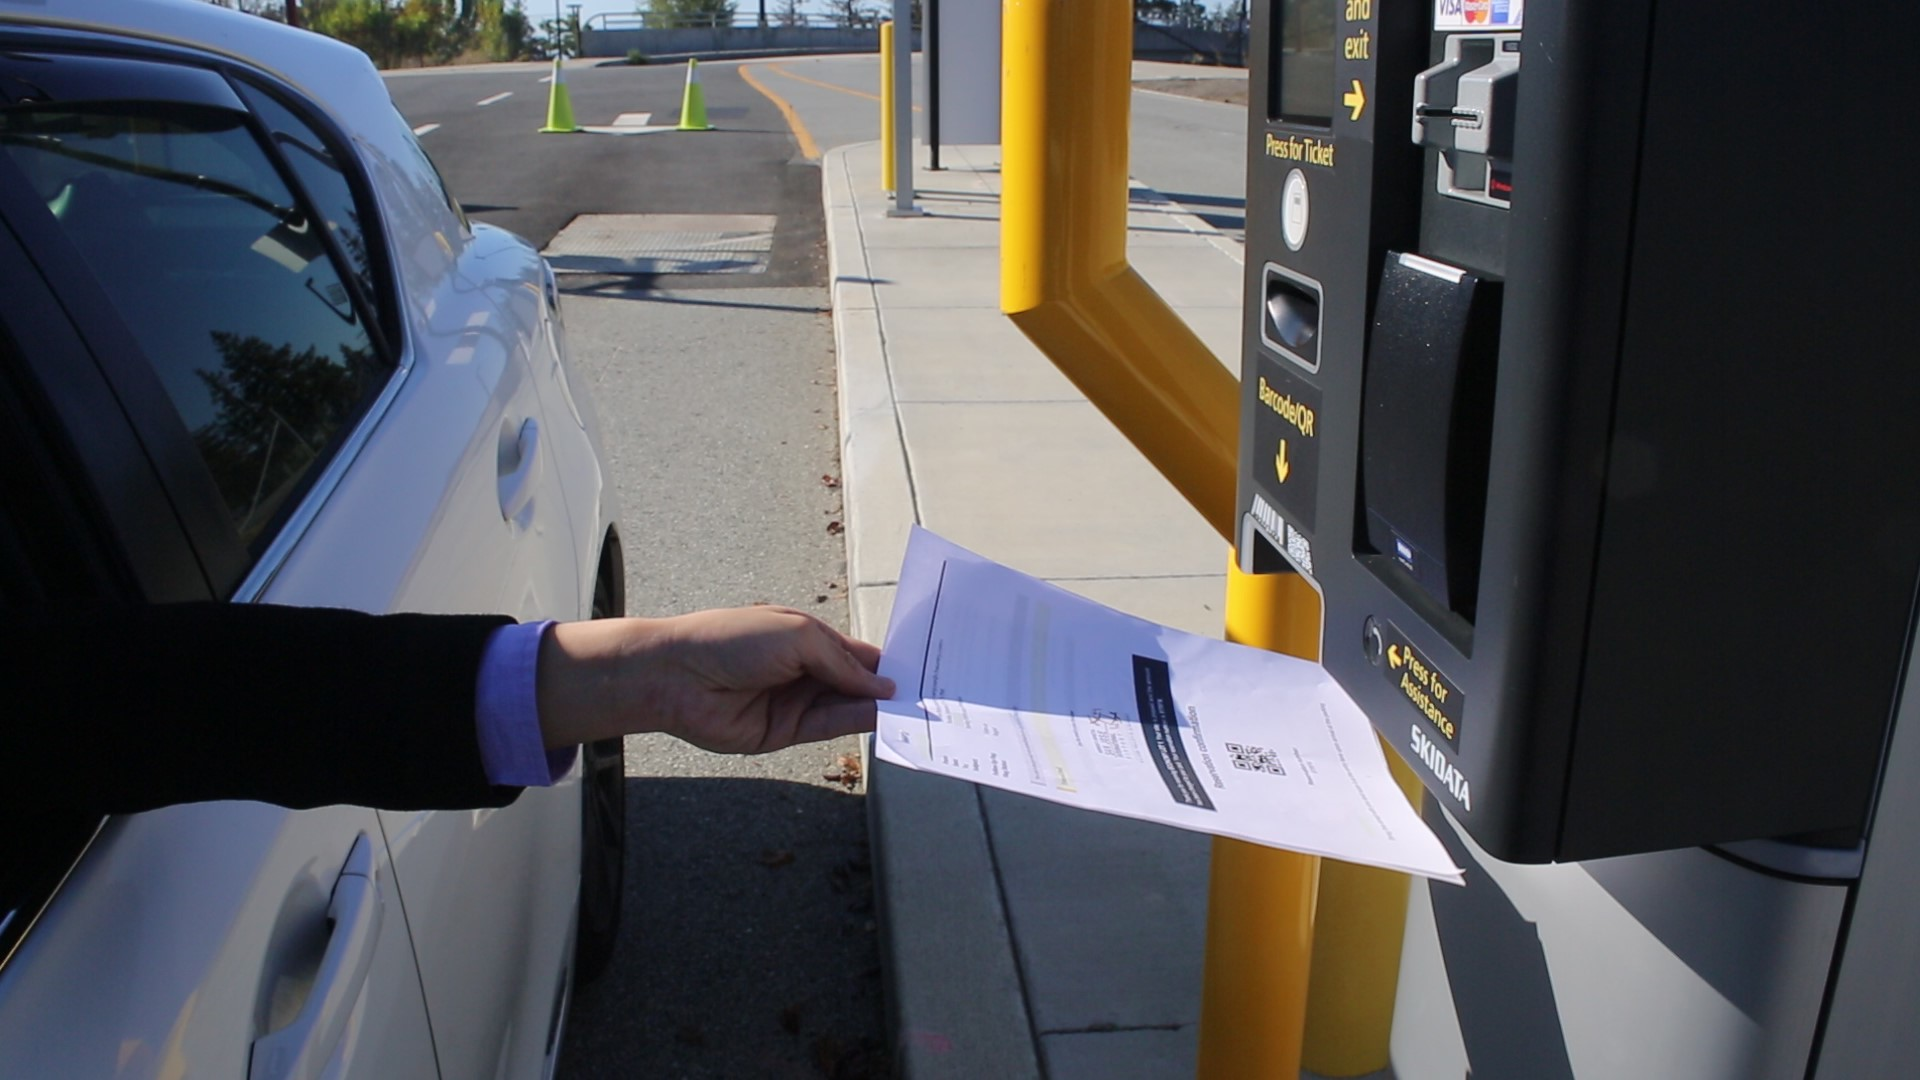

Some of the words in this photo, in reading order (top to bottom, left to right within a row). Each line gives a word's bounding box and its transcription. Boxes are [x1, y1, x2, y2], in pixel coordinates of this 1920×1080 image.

[1345, 0, 1371, 21] and
[1439, 0, 1462, 16] VISA
[1344, 29, 1370, 60] exit
[1266, 133, 1288, 158] Press
[1289, 135, 1303, 161] for
[1303, 138, 1335, 167] Ticket
[1259, 376, 1315, 437] Barcode/QR
[1403, 645, 1429, 687] Press
[1430, 671, 1449, 704] for
[1400, 672, 1455, 740] Assistance
[1410, 724, 1471, 812] SKIDATA
